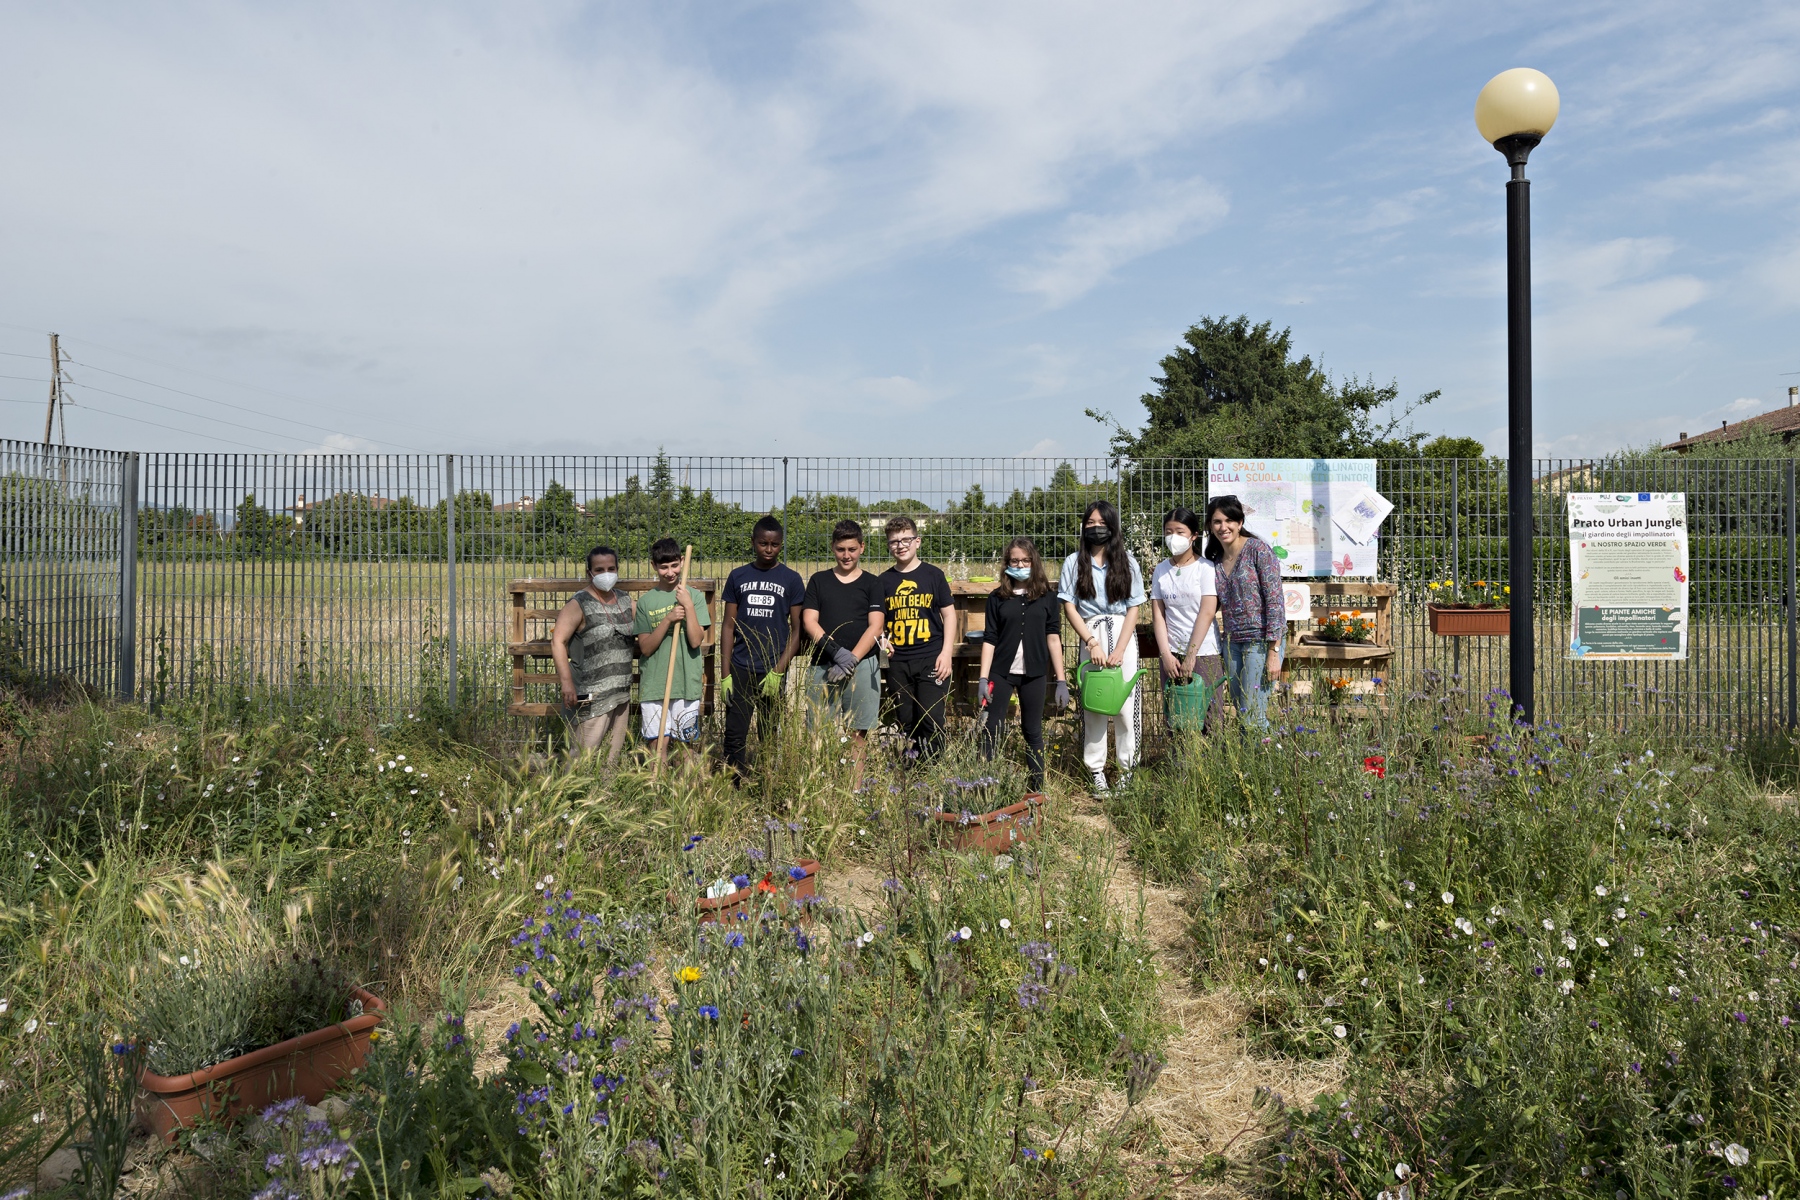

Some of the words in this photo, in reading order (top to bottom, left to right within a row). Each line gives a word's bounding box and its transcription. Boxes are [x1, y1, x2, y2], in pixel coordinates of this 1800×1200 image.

[1212, 462, 1224, 472] LO
[1232, 462, 1265, 472] SPAZIO
[1272, 461, 1300, 472] DEGLI
[1306, 462, 1373, 472] IMPOLLINATORI
[1211, 473, 1240, 483] DELLA
[1246, 473, 1282, 482] SCUOLA
[1336, 473, 1372, 482] TINTORI
[1573, 518, 1605, 528] Prato
[1608, 518, 1643, 528] Urban
[1645, 517, 1682, 529] Jungle
[1588, 531, 1615, 539] giardino
[1616, 531, 1632, 539] degli
[740, 581, 758, 593] TEAM
[759, 581, 785, 597] MASTER
[747, 607, 774, 618] VARSITY
[887, 618, 931, 646] 1974
